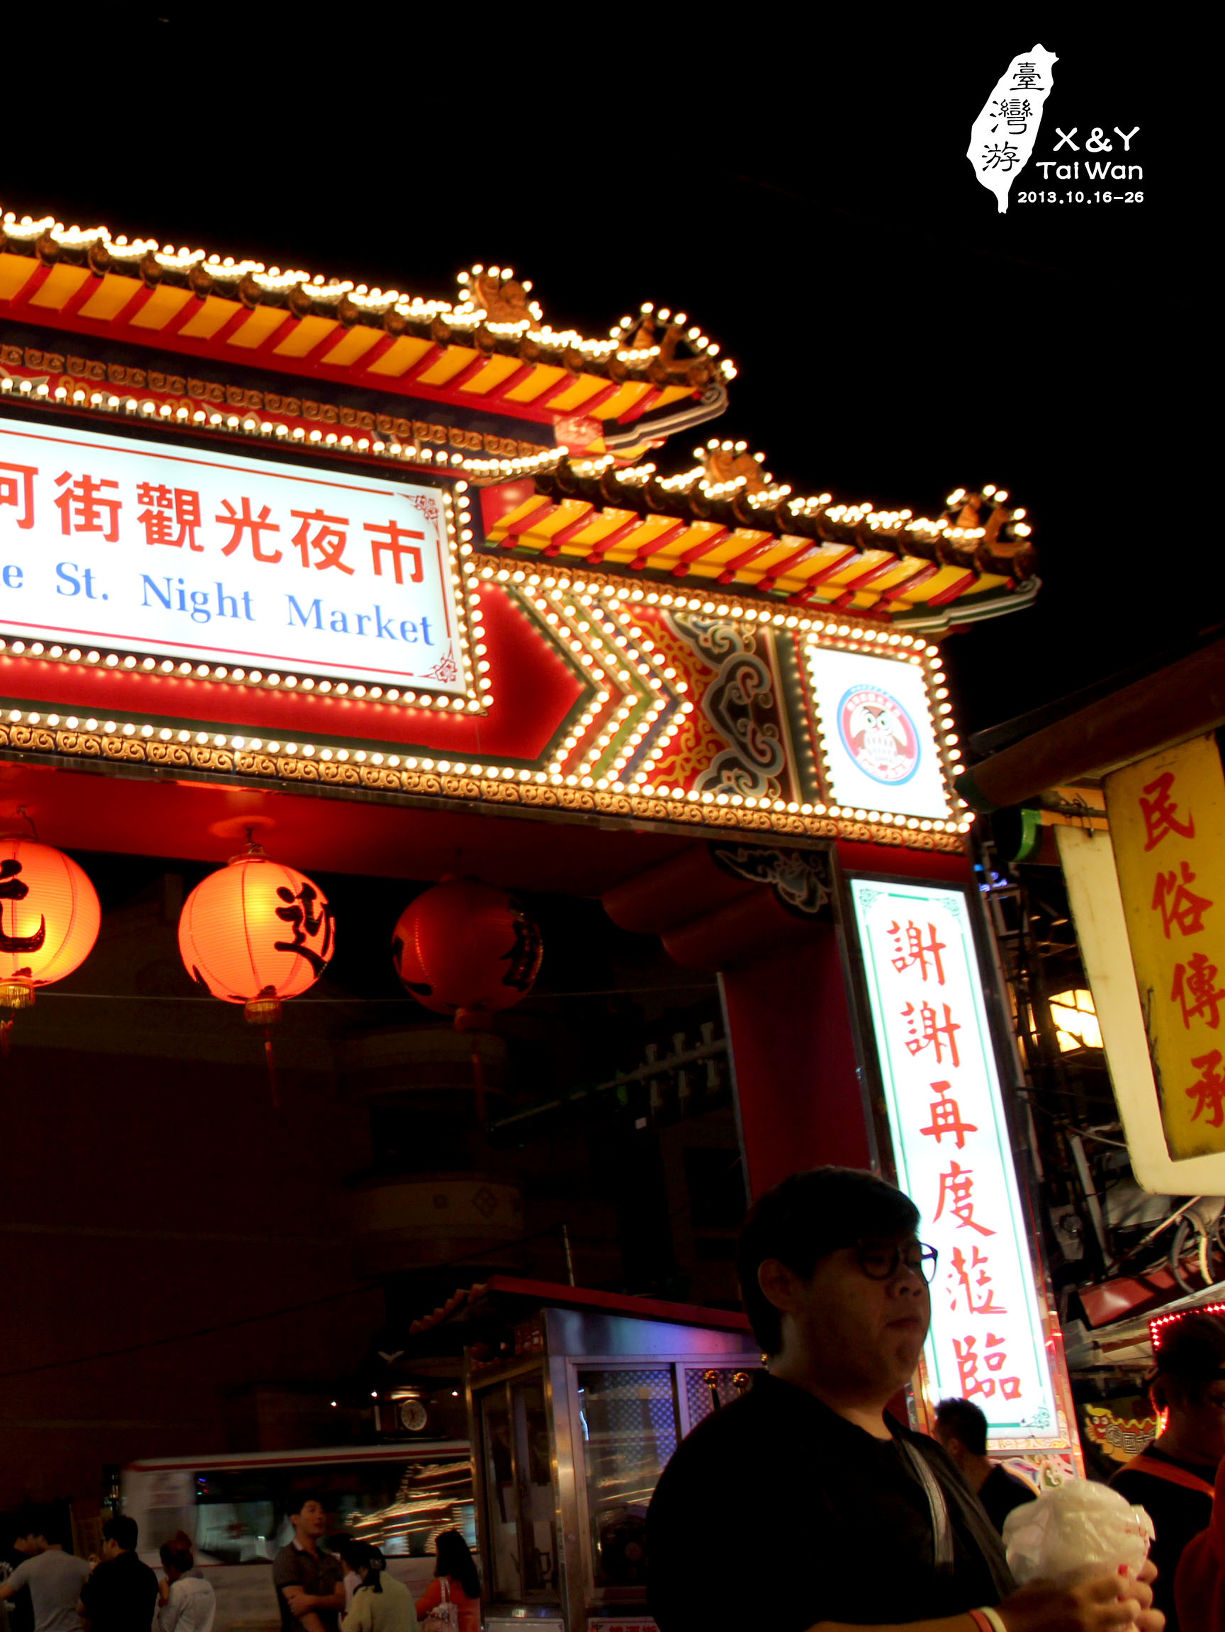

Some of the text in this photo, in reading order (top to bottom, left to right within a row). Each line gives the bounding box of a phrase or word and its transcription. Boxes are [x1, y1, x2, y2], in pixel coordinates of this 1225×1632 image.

[55, 562, 109, 600] St.
[141, 574, 255, 624] Night
[287, 594, 435, 647] Market
[886, 920, 1023, 1401] 謝謝再度蒞臨
